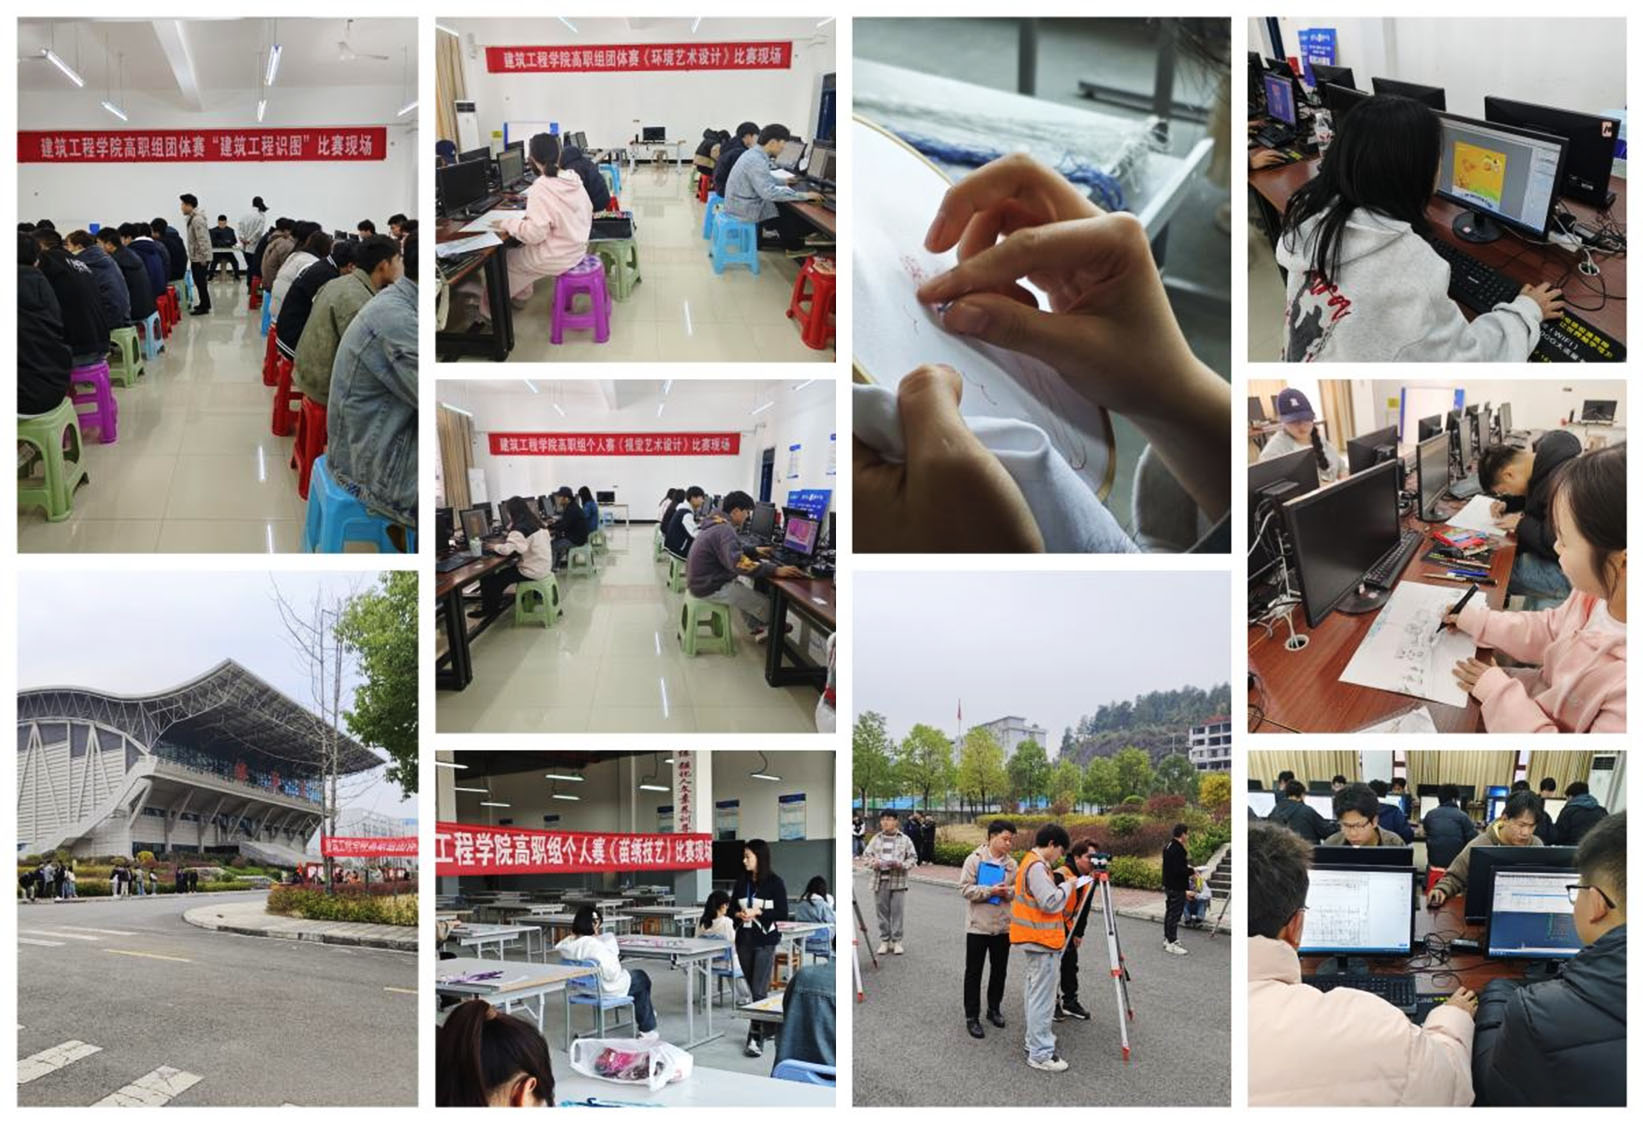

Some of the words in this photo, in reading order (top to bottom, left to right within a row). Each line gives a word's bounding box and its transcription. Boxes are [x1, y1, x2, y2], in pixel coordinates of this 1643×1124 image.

[503, 47, 782, 69] 建筑工程学院高职组团体赛《环境艺术设计》比赛现场
[500, 437, 731, 454] 建筑工程学院高职组个人赛《视觉艺术设计》比赛现场
